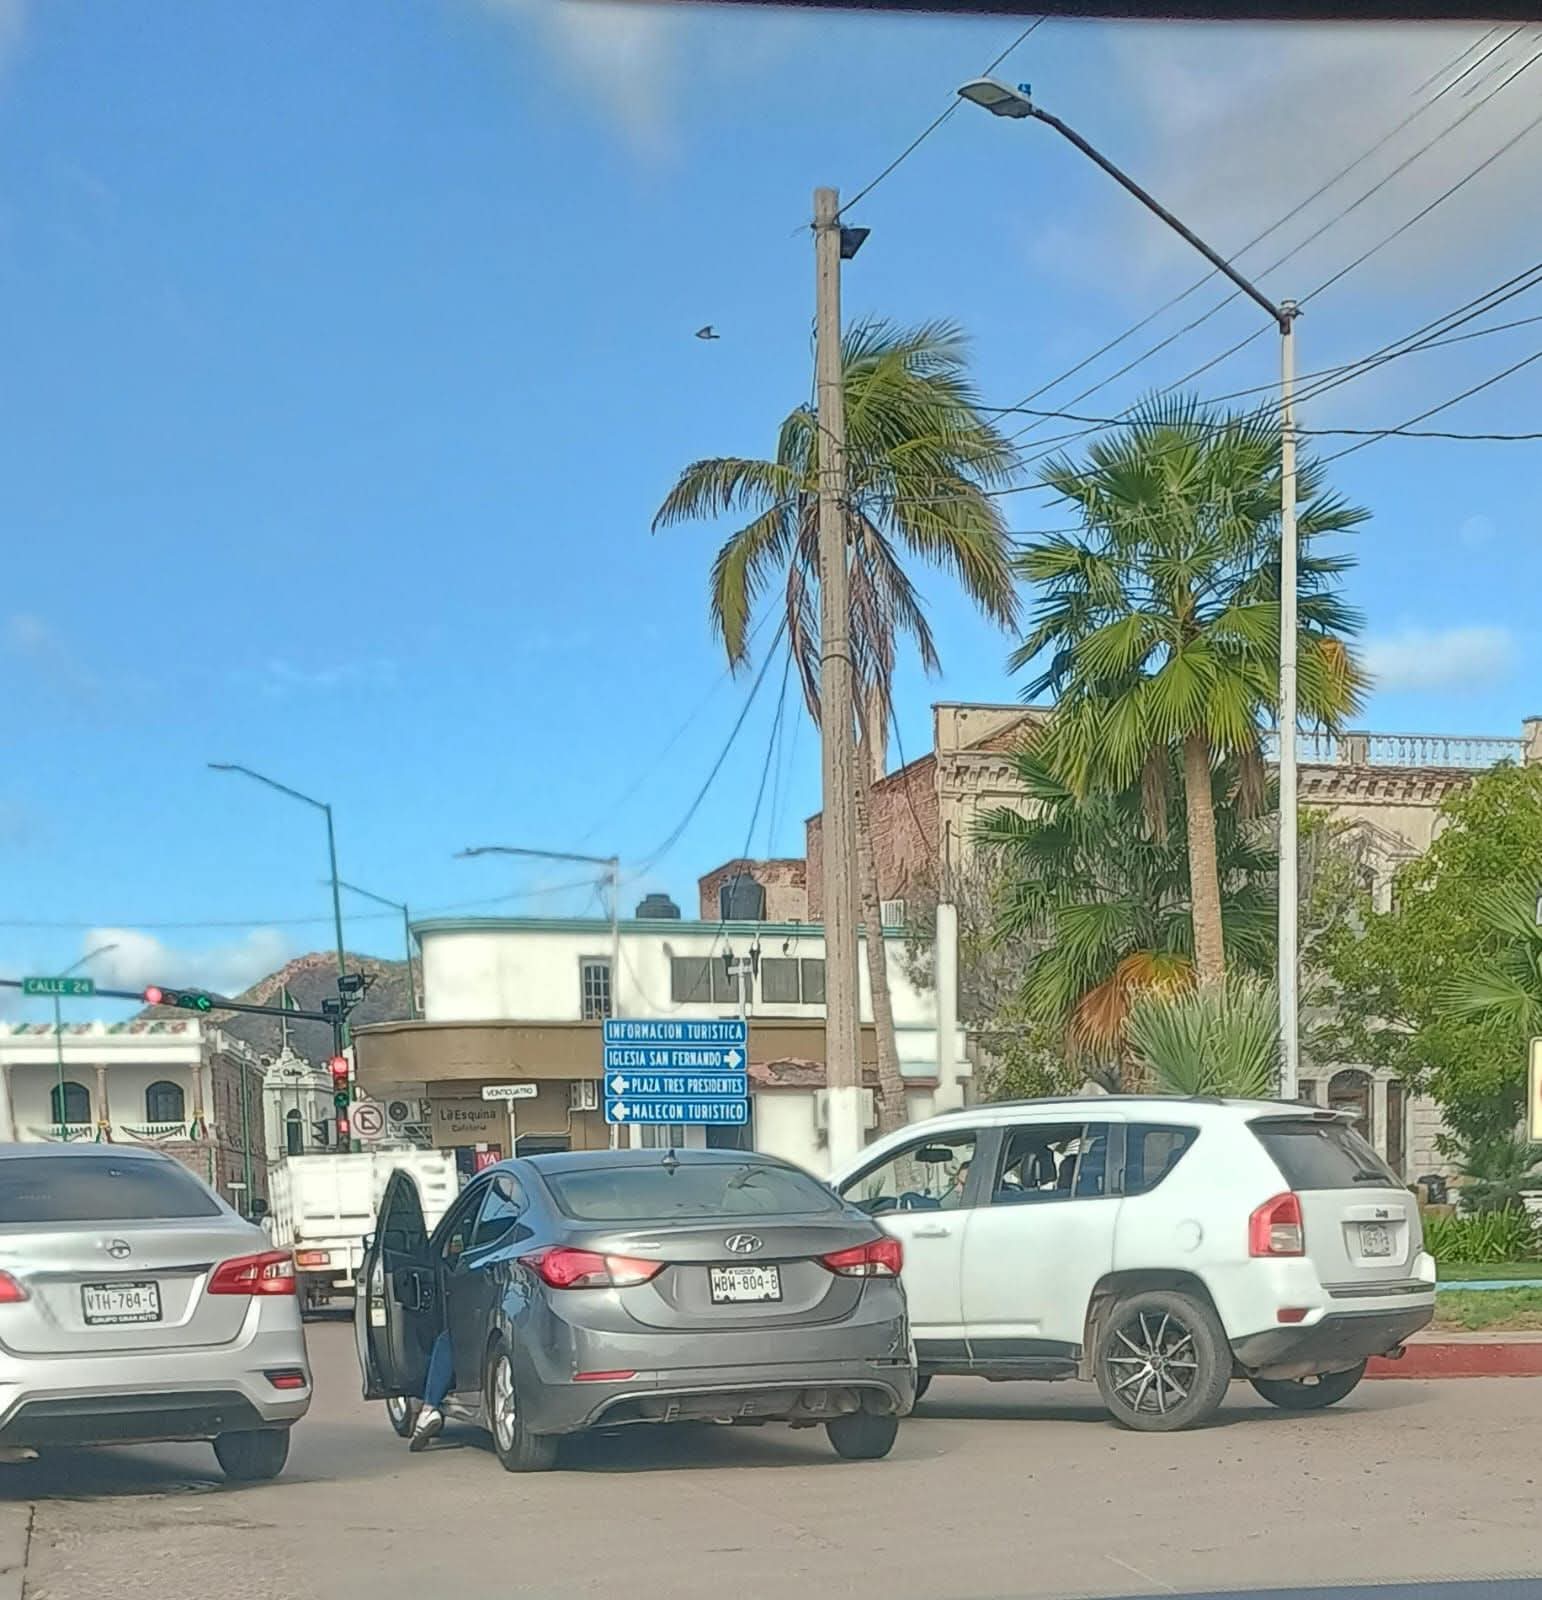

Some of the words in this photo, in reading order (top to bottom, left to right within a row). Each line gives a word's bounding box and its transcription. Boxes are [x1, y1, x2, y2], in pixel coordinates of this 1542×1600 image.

[29, 981, 66, 992] CALLE
[73, 981, 90, 992] 24
[609, 1023, 682, 1039] INFORMACION
[688, 1023, 743, 1039] TURISTICA
[609, 1050, 645, 1066] IGLESIA
[650, 1051, 668, 1066] SAN
[672, 1051, 721, 1066] FERNANDO
[632, 1078, 661, 1093] PLAZA
[664, 1078, 684, 1093] TRES
[687, 1078, 743, 1093] PRESIDENTES
[455, 1110, 496, 1121] Esquina
[632, 1104, 683, 1119] MALECON
[688, 1104, 743, 1119] TURISTICO
[87, 1292, 156, 1310] VTH-784-C
